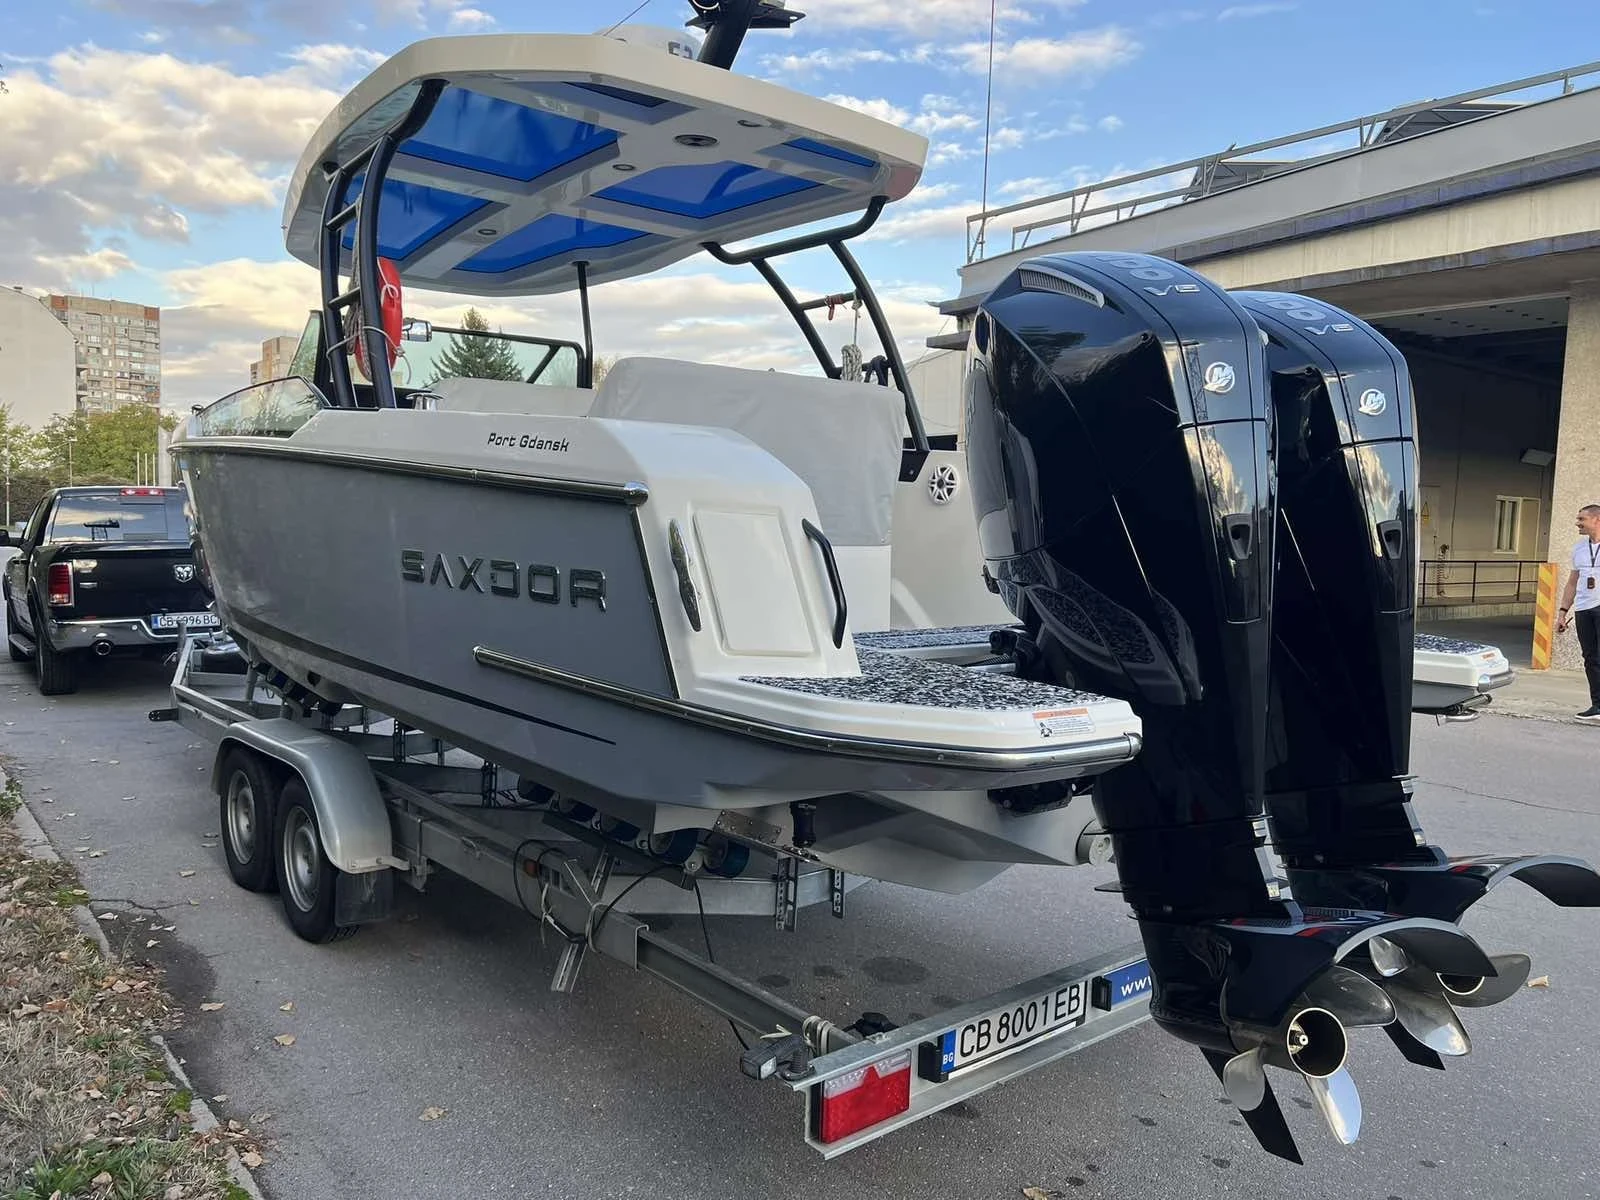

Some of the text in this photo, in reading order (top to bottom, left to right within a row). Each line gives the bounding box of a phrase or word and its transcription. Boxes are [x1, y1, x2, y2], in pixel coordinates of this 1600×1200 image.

[487, 432, 570, 452] Port Gdansk
[401, 549, 607, 612] SAXDOR
[960, 984, 1080, 1058] CB 8001 EB
[942, 1052, 954, 1065] BG
